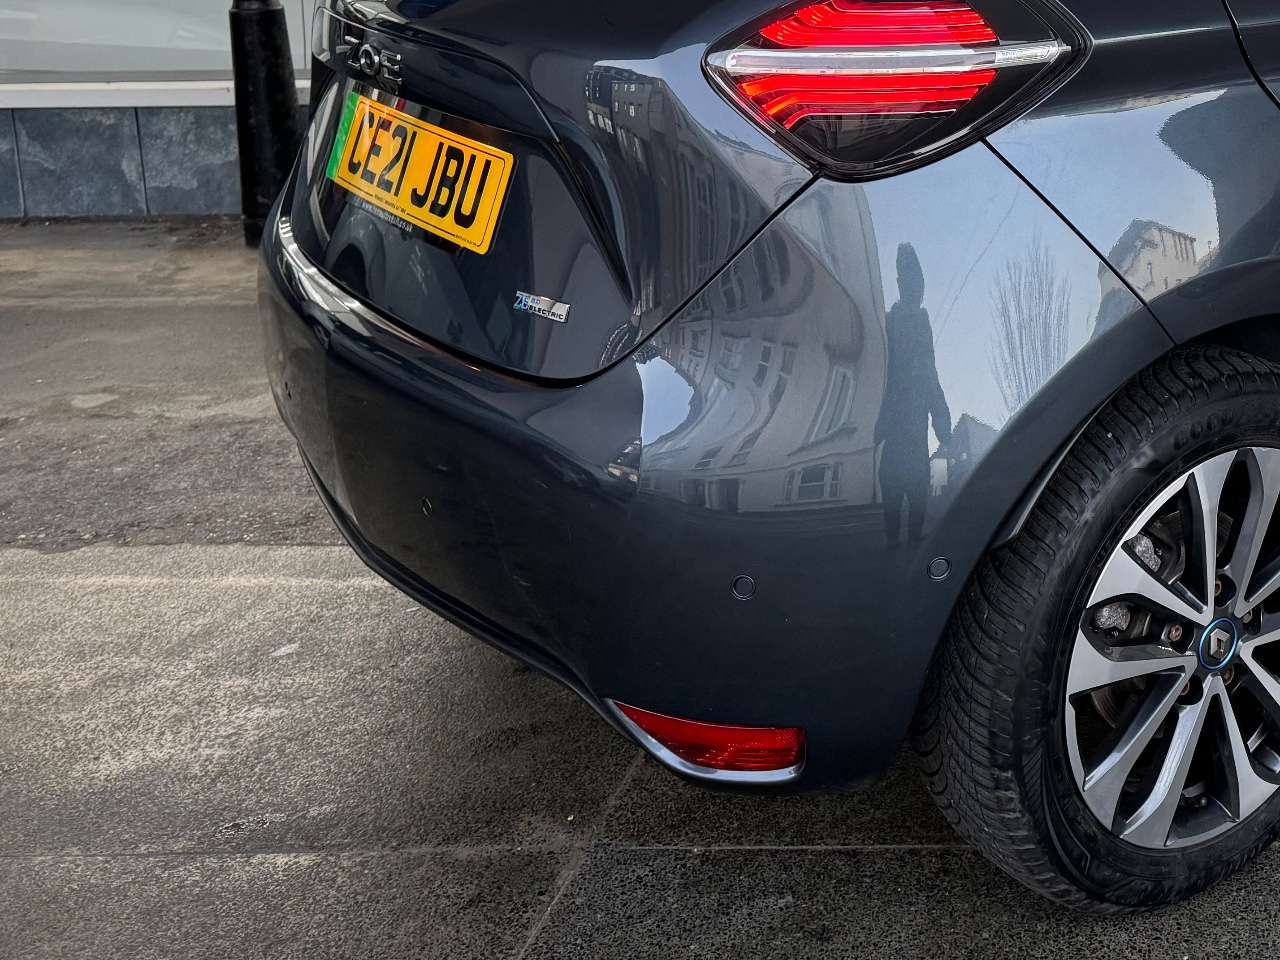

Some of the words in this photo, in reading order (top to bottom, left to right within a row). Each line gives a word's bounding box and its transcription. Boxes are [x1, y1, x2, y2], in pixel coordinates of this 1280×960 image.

[344, 35, 402, 81] ZOE
[347, 111, 418, 197] CE21
[410, 141, 492, 229] JBU
[529, 304, 565, 320] ELECTRIC
